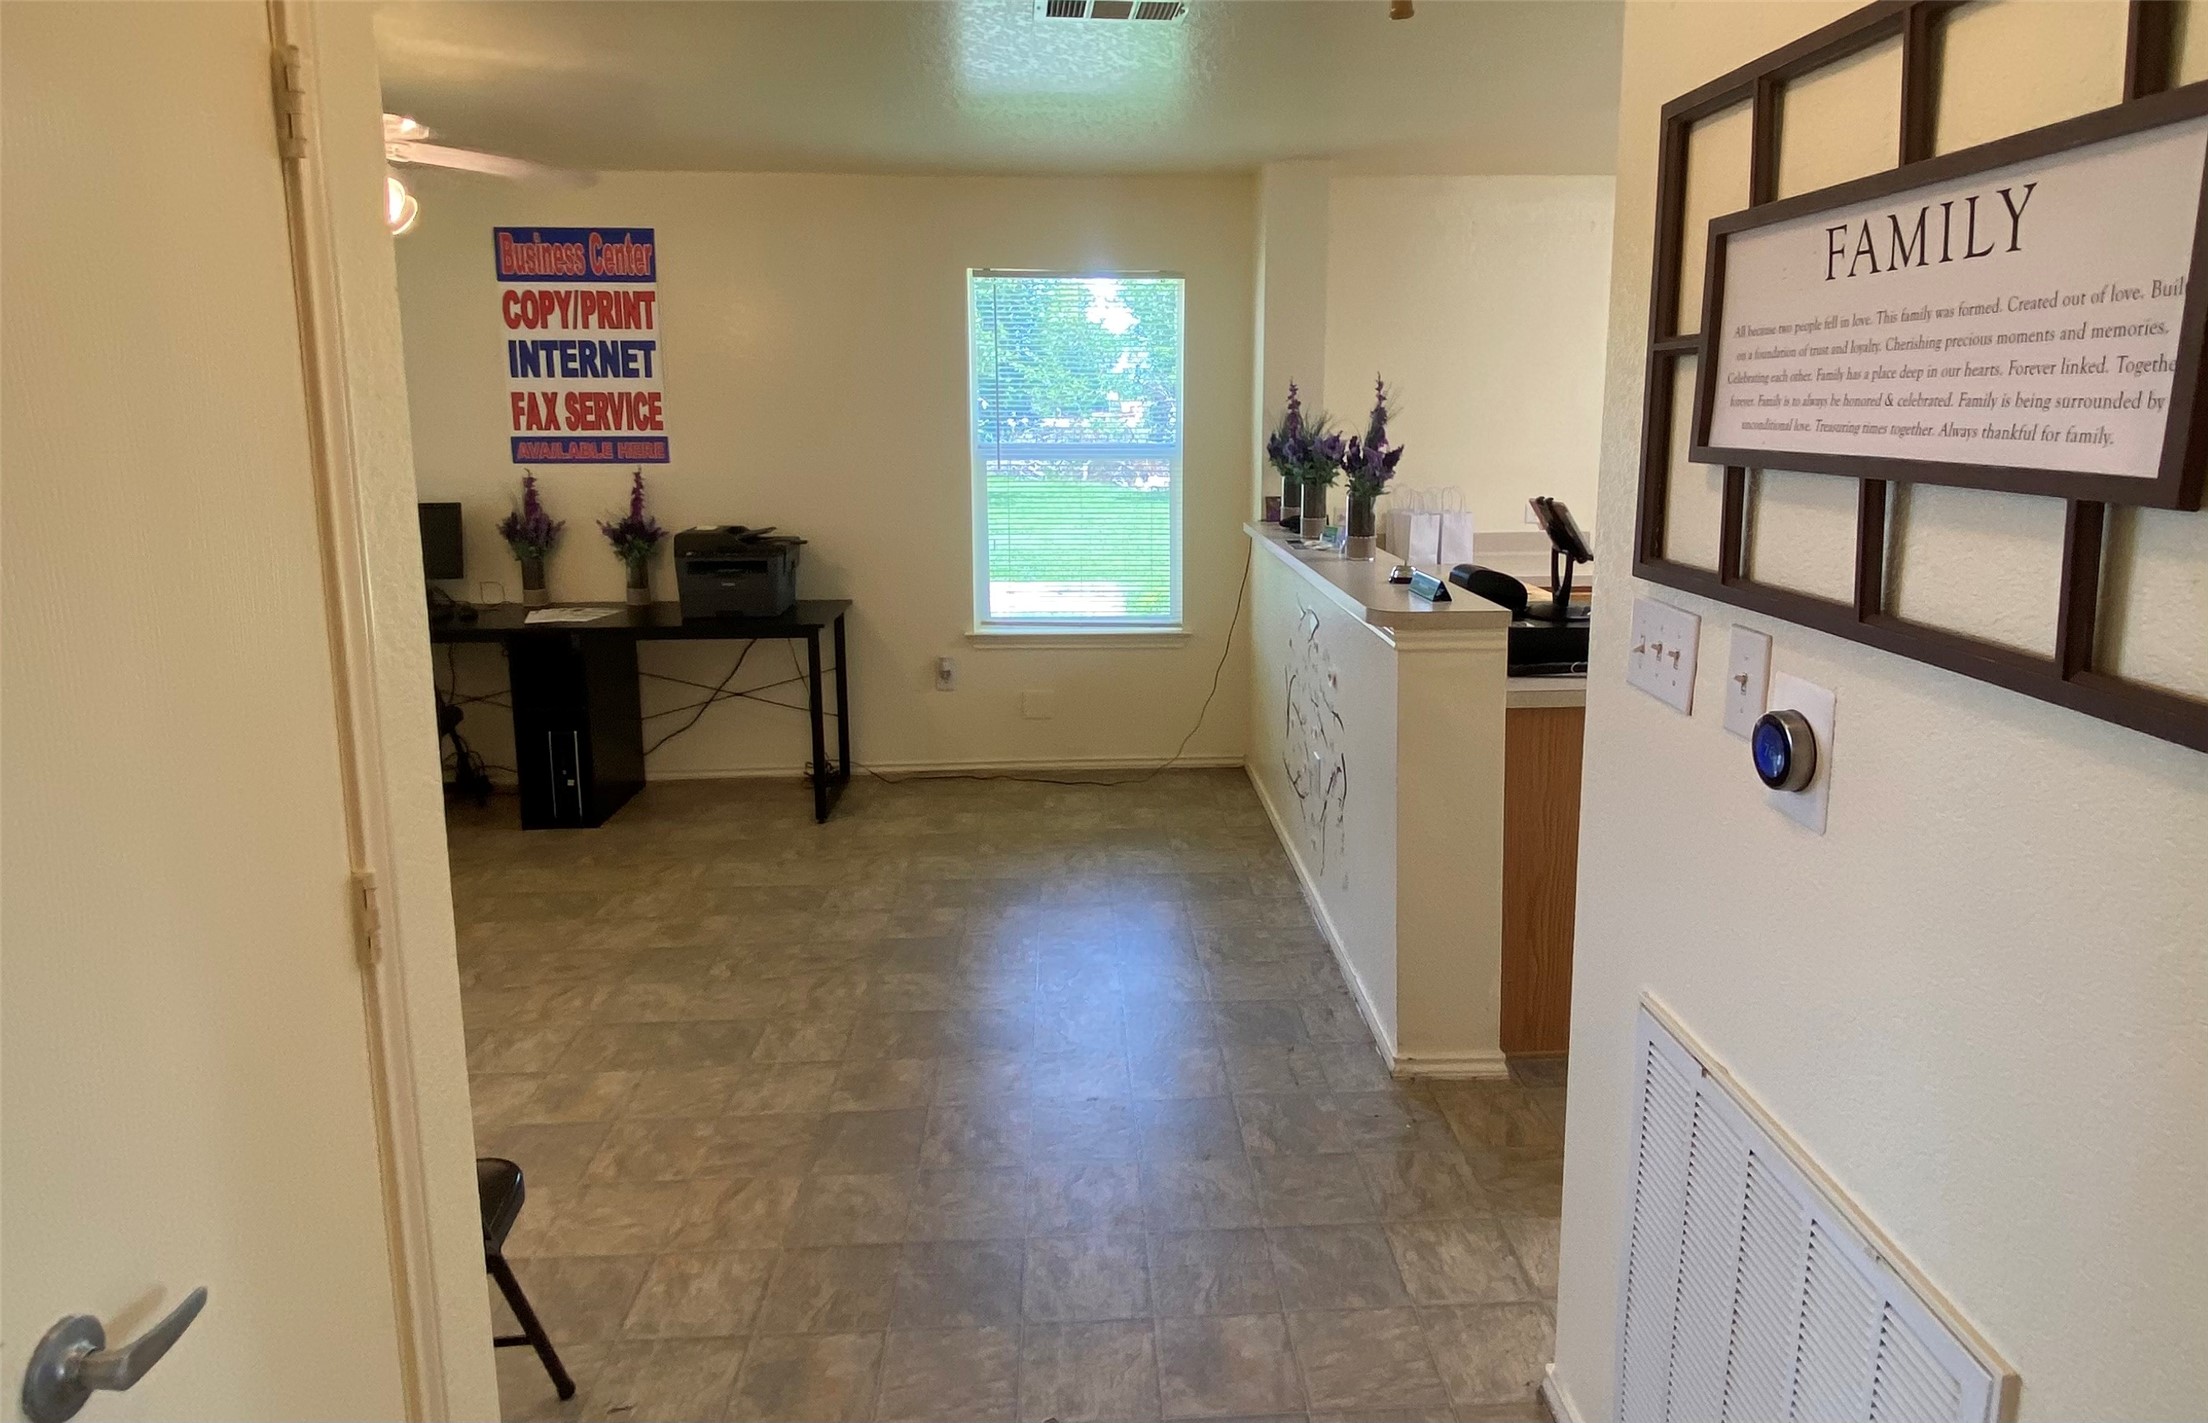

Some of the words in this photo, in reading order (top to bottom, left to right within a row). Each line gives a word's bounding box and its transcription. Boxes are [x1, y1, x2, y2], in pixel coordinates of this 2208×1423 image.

[1825, 182, 2037, 281] FAMILY
[498, 232, 586, 275] Business
[589, 232, 652, 276] Center
[502, 290, 655, 330] COPY/PRINT
[1734, 326, 1746, 338] All
[1748, 327, 1775, 336] because
[1795, 318, 1822, 335] people
[1824, 316, 1838, 330] fell
[1841, 319, 1849, 328] in
[1852, 314, 1872, 327] love.
[1877, 310, 1897, 324] This
[1901, 305, 1931, 323] family
[1936, 308, 1954, 318] was
[1959, 297, 2002, 316] formed.
[2008, 290, 2058, 312] Created
[2062, 296, 2086, 307] out
[2090, 284, 2108, 303] of
[2111, 284, 2144, 302] love.
[2151, 276, 2184, 298] Buil
[508, 340, 656, 378] INTERNET
[1755, 346, 1796, 360] foundation
[1799, 343, 1809, 357] of
[1810, 347, 1829, 356] trust
[1831, 340, 1848, 355] and
[1886, 334, 1942, 351] Cherishing
[1945, 333, 1992, 351] precious
[1997, 330, 2055, 344] moments
[2060, 322, 2087, 340] and
[2091, 319, 2169, 339] memories.
[1727, 372, 1769, 385] Celebrating
[1771, 369, 1788, 383] each
[1790, 371, 1813, 382] other.
[1816, 367, 1845, 382] Family
[1847, 367, 1861, 380] has
[1871, 365, 1896, 382] place
[1900, 364, 1924, 381] deep
[1927, 365, 1937, 378] in
[1941, 367, 1961, 377] our
[1964, 362, 2002, 377] hearts.
[2008, 360, 2056, 375] Forever
[2061, 355, 2108, 374] linked.
[2116, 353, 2176, 377] Togethe
[511, 392, 561, 431] FAX
[565, 392, 664, 431] SERVICE
[1758, 393, 1782, 408] Family
[1783, 396, 1790, 406] is
[1802, 393, 1828, 409] always
[1830, 393, 1841, 406] be
[1843, 393, 1883, 407] honored
[1885, 393, 1893, 406] &
[1897, 392, 1953, 407] celebrated.
[1958, 391, 1998, 410] Family
[2001, 395, 2011, 408] is
[2015, 391, 2051, 412] being
[2055, 390, 2142, 409] surrounded
[2147, 391, 2165, 412] by
[517, 441, 613, 459] AVAILABLE
[617, 442, 665, 459] HERE
[1742, 418, 1793, 432] unconditional
[1795, 420, 1811, 432] love.
[1816, 419, 1861, 435] Treasuring
[1861, 425, 1887, 434] times
[1890, 421, 1935, 438] together.
[1938, 422, 1978, 439] Always
[1982, 422, 2037, 443] thankful
[2041, 425, 2061, 442] for
[2065, 425, 2114, 448] family.
